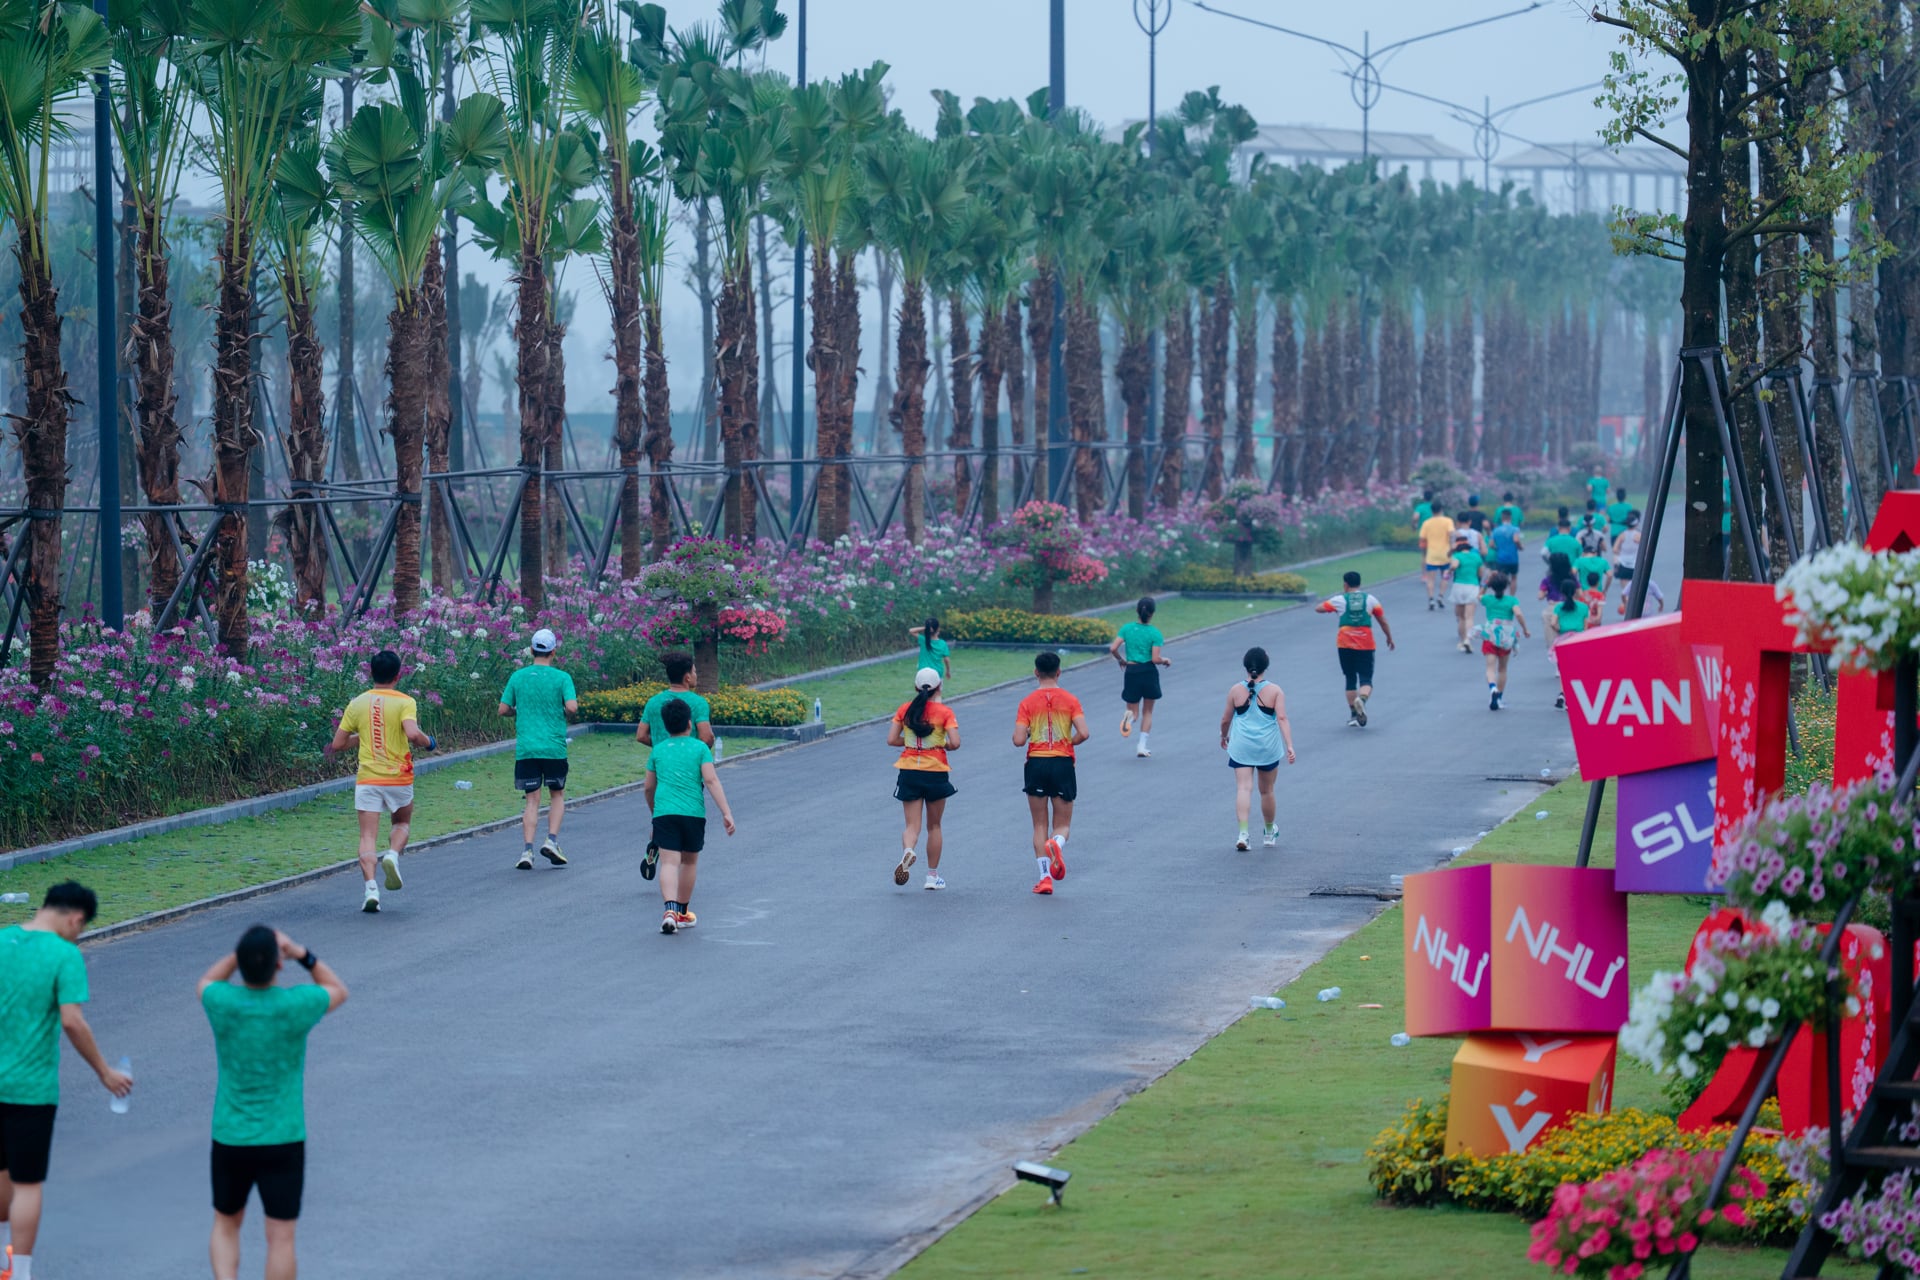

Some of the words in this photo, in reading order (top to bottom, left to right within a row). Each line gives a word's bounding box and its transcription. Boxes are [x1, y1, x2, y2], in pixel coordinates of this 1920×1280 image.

[1570, 679, 1692, 737] VẠN
[1413, 914, 1489, 998] NHƯ
[1505, 905, 1625, 999] NHƯ
[1489, 1089, 1553, 1154] Ý
